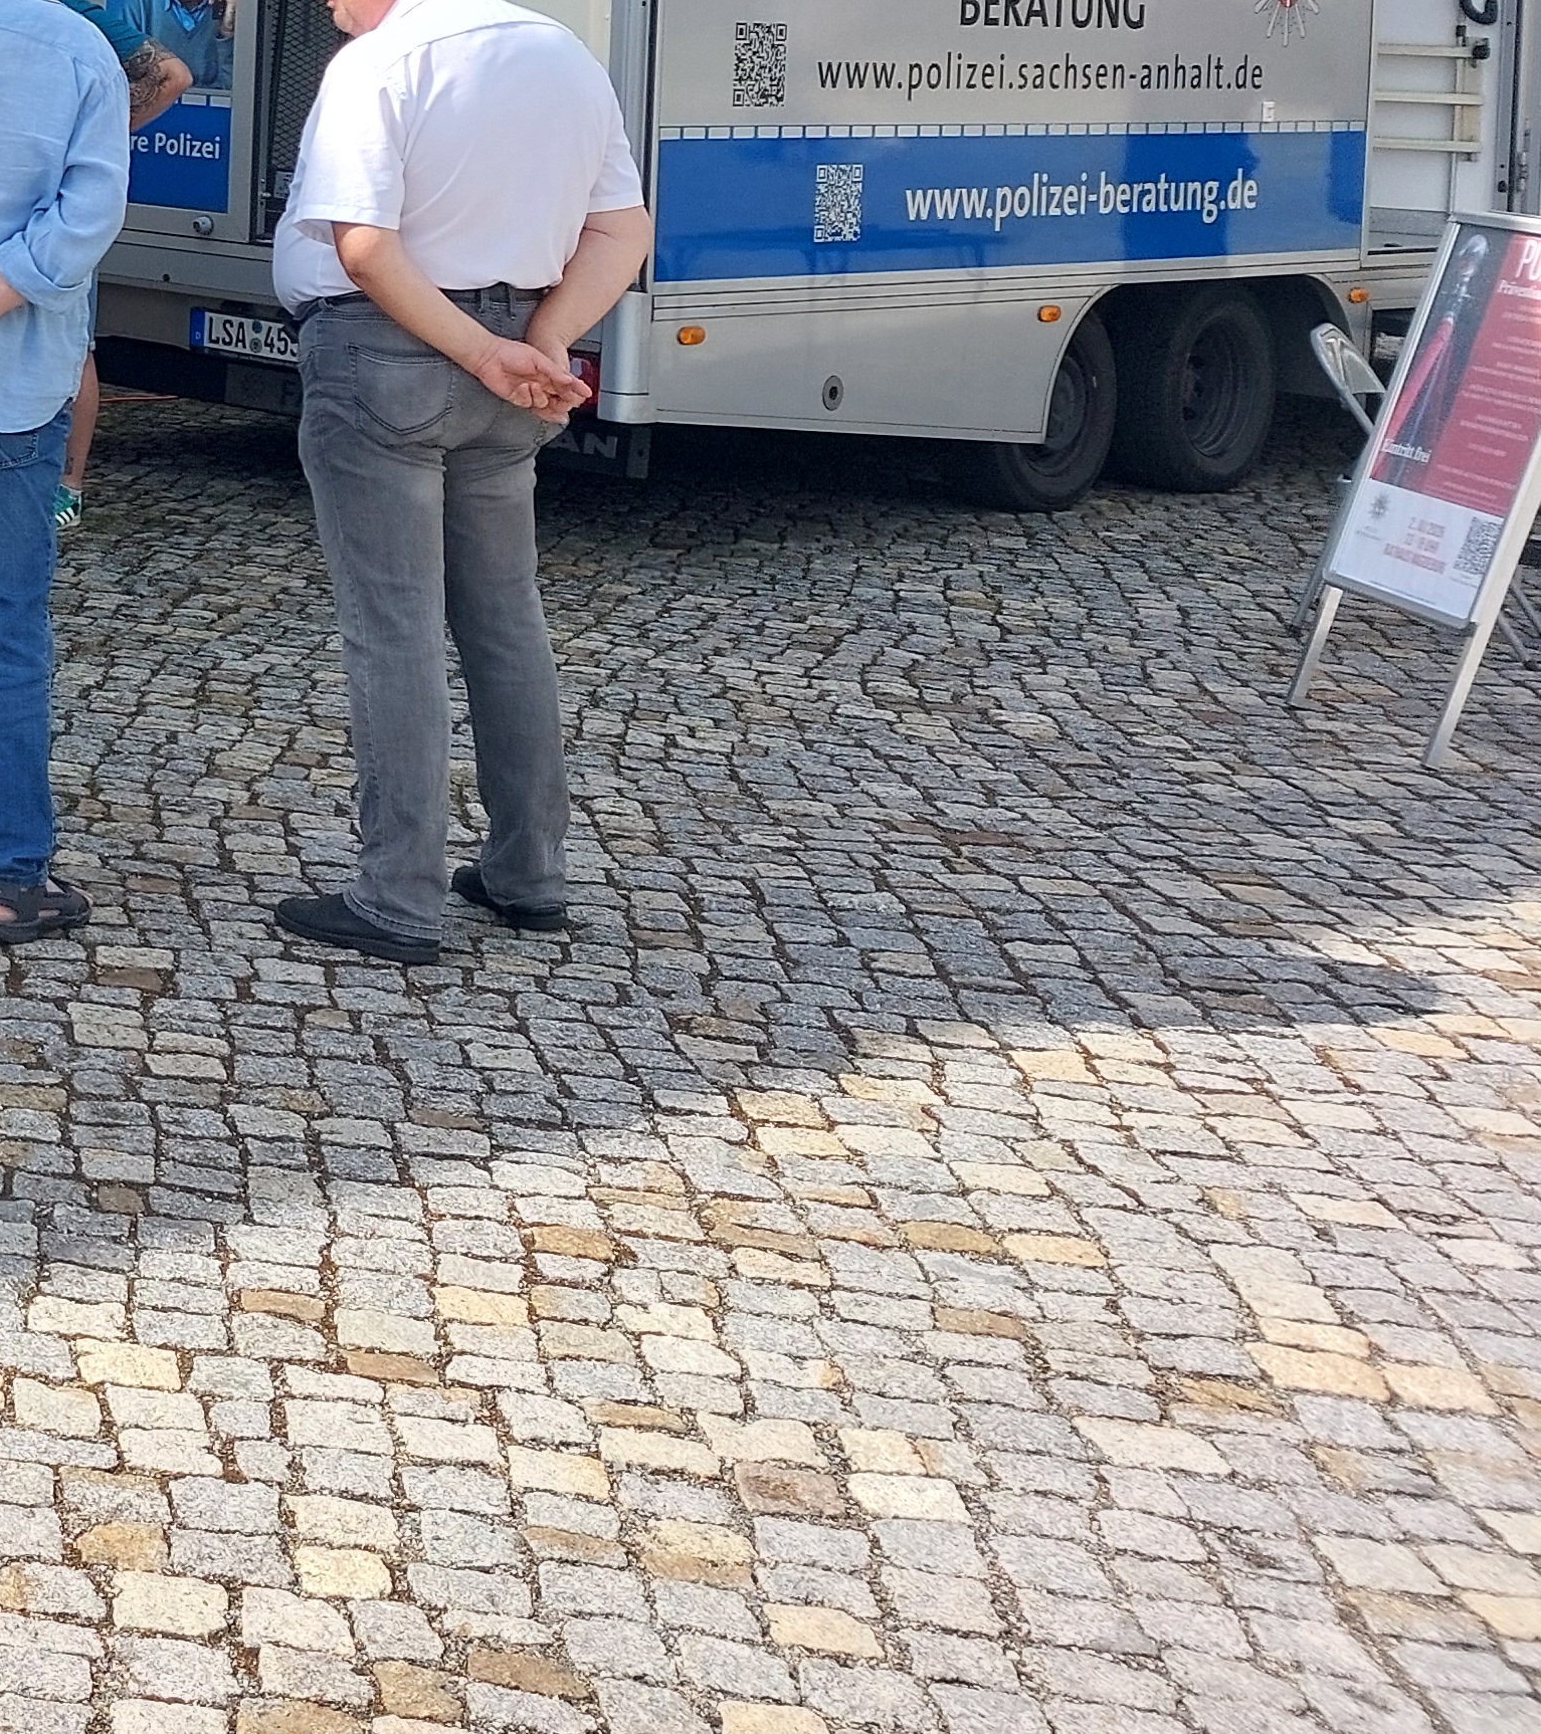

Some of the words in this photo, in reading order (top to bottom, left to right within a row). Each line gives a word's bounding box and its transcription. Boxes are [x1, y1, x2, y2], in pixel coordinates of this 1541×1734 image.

[817, 51, 1264, 101] www.polizei.sachsen-anhalt.de
[154, 132, 222, 160] Polizei
[905, 168, 1258, 231] www.polizei-beratung.de
[208, 316, 247, 349] LSA
